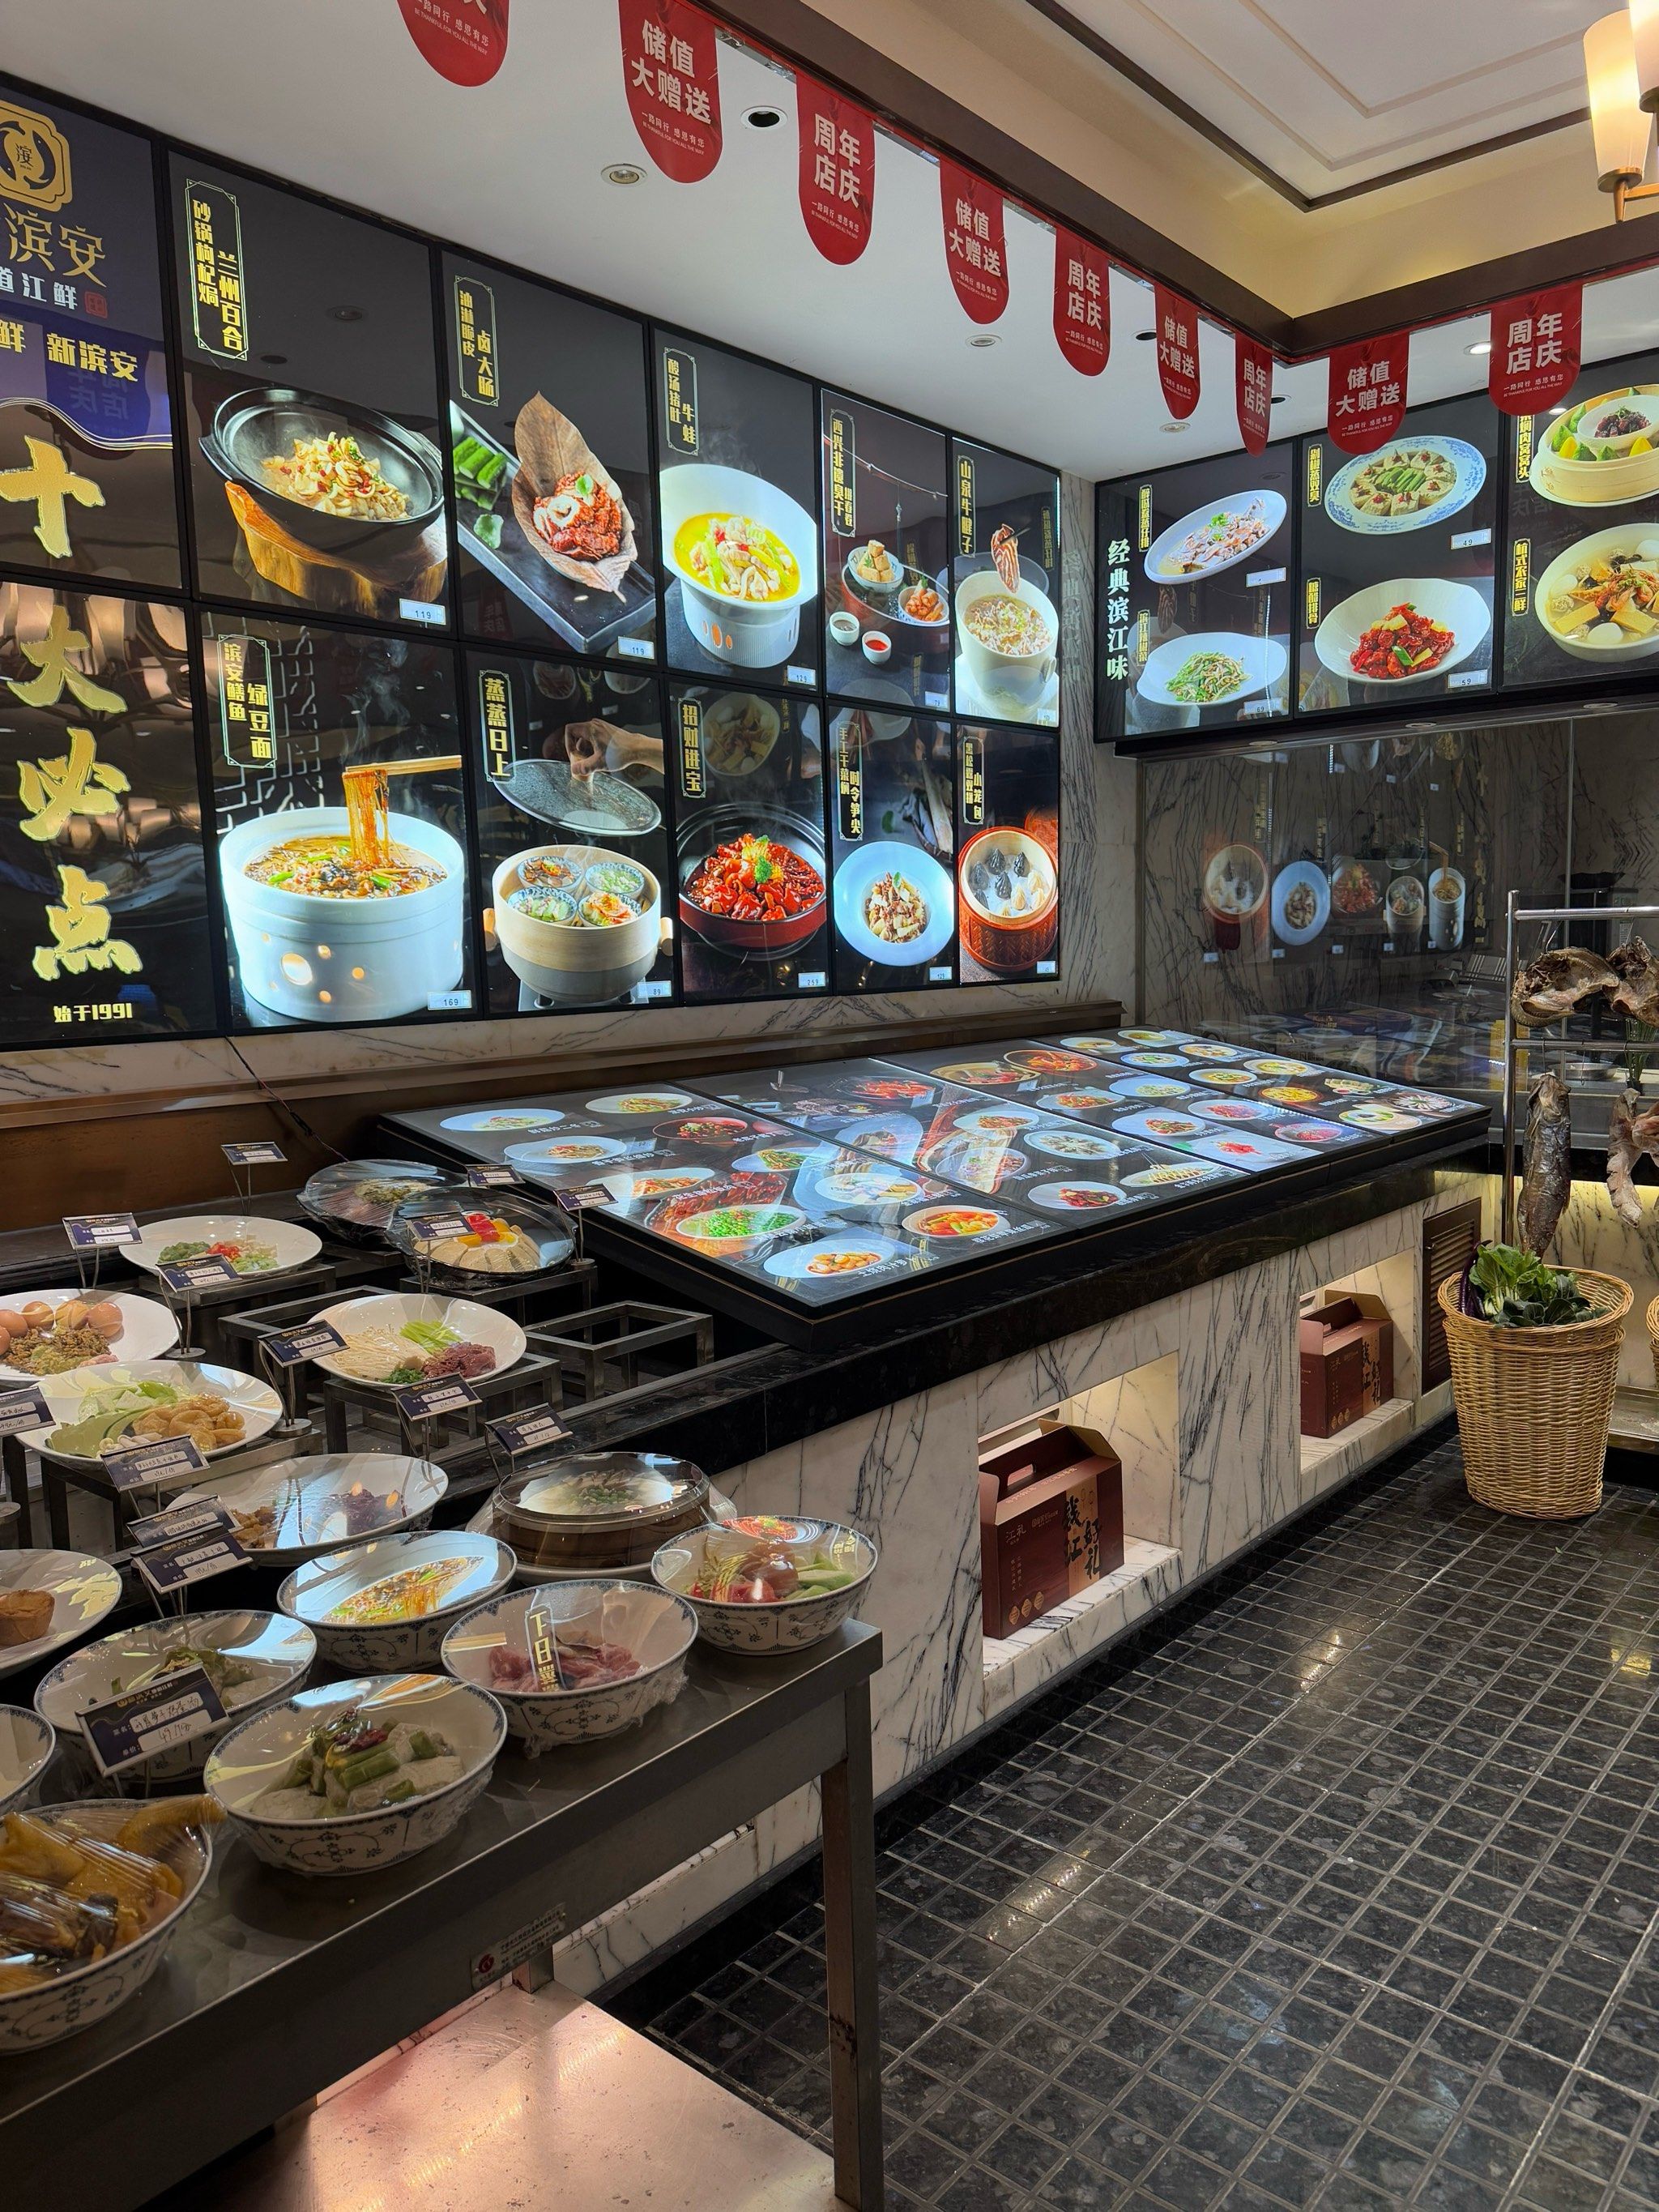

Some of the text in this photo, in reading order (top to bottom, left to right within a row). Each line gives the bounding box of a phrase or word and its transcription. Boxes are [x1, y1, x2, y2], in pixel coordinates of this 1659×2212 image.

[417, 0, 451, 23] 路同行
[455, 19, 489, 47] 感恩有您
[642, 19, 695, 79] 储值
[631, 58, 711, 124] 大赠送
[642, 111, 705, 148] 一路同行 感恩有您
[814, 113, 860, 168] 周年
[814, 154, 860, 208] 店庆
[812, 202, 834, 219] 一路同行
[956, 198, 990, 241] 储值
[193, 199, 219, 308] 砂锅枸杞焗
[949, 228, 1000, 277] 大赠送
[1068, 258, 1101, 299] 周年
[217, 250, 243, 352] 兰州百合
[1068, 292, 1102, 331] 店庆
[459, 290, 476, 358] 油淋脆皮
[1165, 315, 1188, 349] 储值
[1508, 313, 1563, 348] 周年
[47, 332, 139, 382] 新滨安
[477, 329, 495, 398] 卤大肠
[1159, 341, 1195, 379] 大赠送
[1243, 358, 1266, 391] 周年
[1347, 361, 1389, 390] 储值
[1506, 340, 1563, 375] 店庆
[1243, 386, 1265, 417] 店庆
[1335, 382, 1400, 417] 大赠送
[1503, 374, 1563, 391] 一路同行 感恩有您
[1341, 421, 1367, 431] 一路同行
[1463, 538, 1473, 547] 49
[416, 610, 432, 619] 119
[1107, 537, 1131, 681] 经典滨江味
[632, 647, 645, 655] 119
[224, 643, 248, 721] 滨安鳝鱼
[1461, 677, 1472, 685] 59
[247, 682, 272, 759] 绿豆面
[484, 677, 511, 777] 蒸蒸日上
[683, 703, 702, 792] 招财进宝
[53, 1001, 133, 1024] 始于1991
[444, 998, 458, 1006] 169
